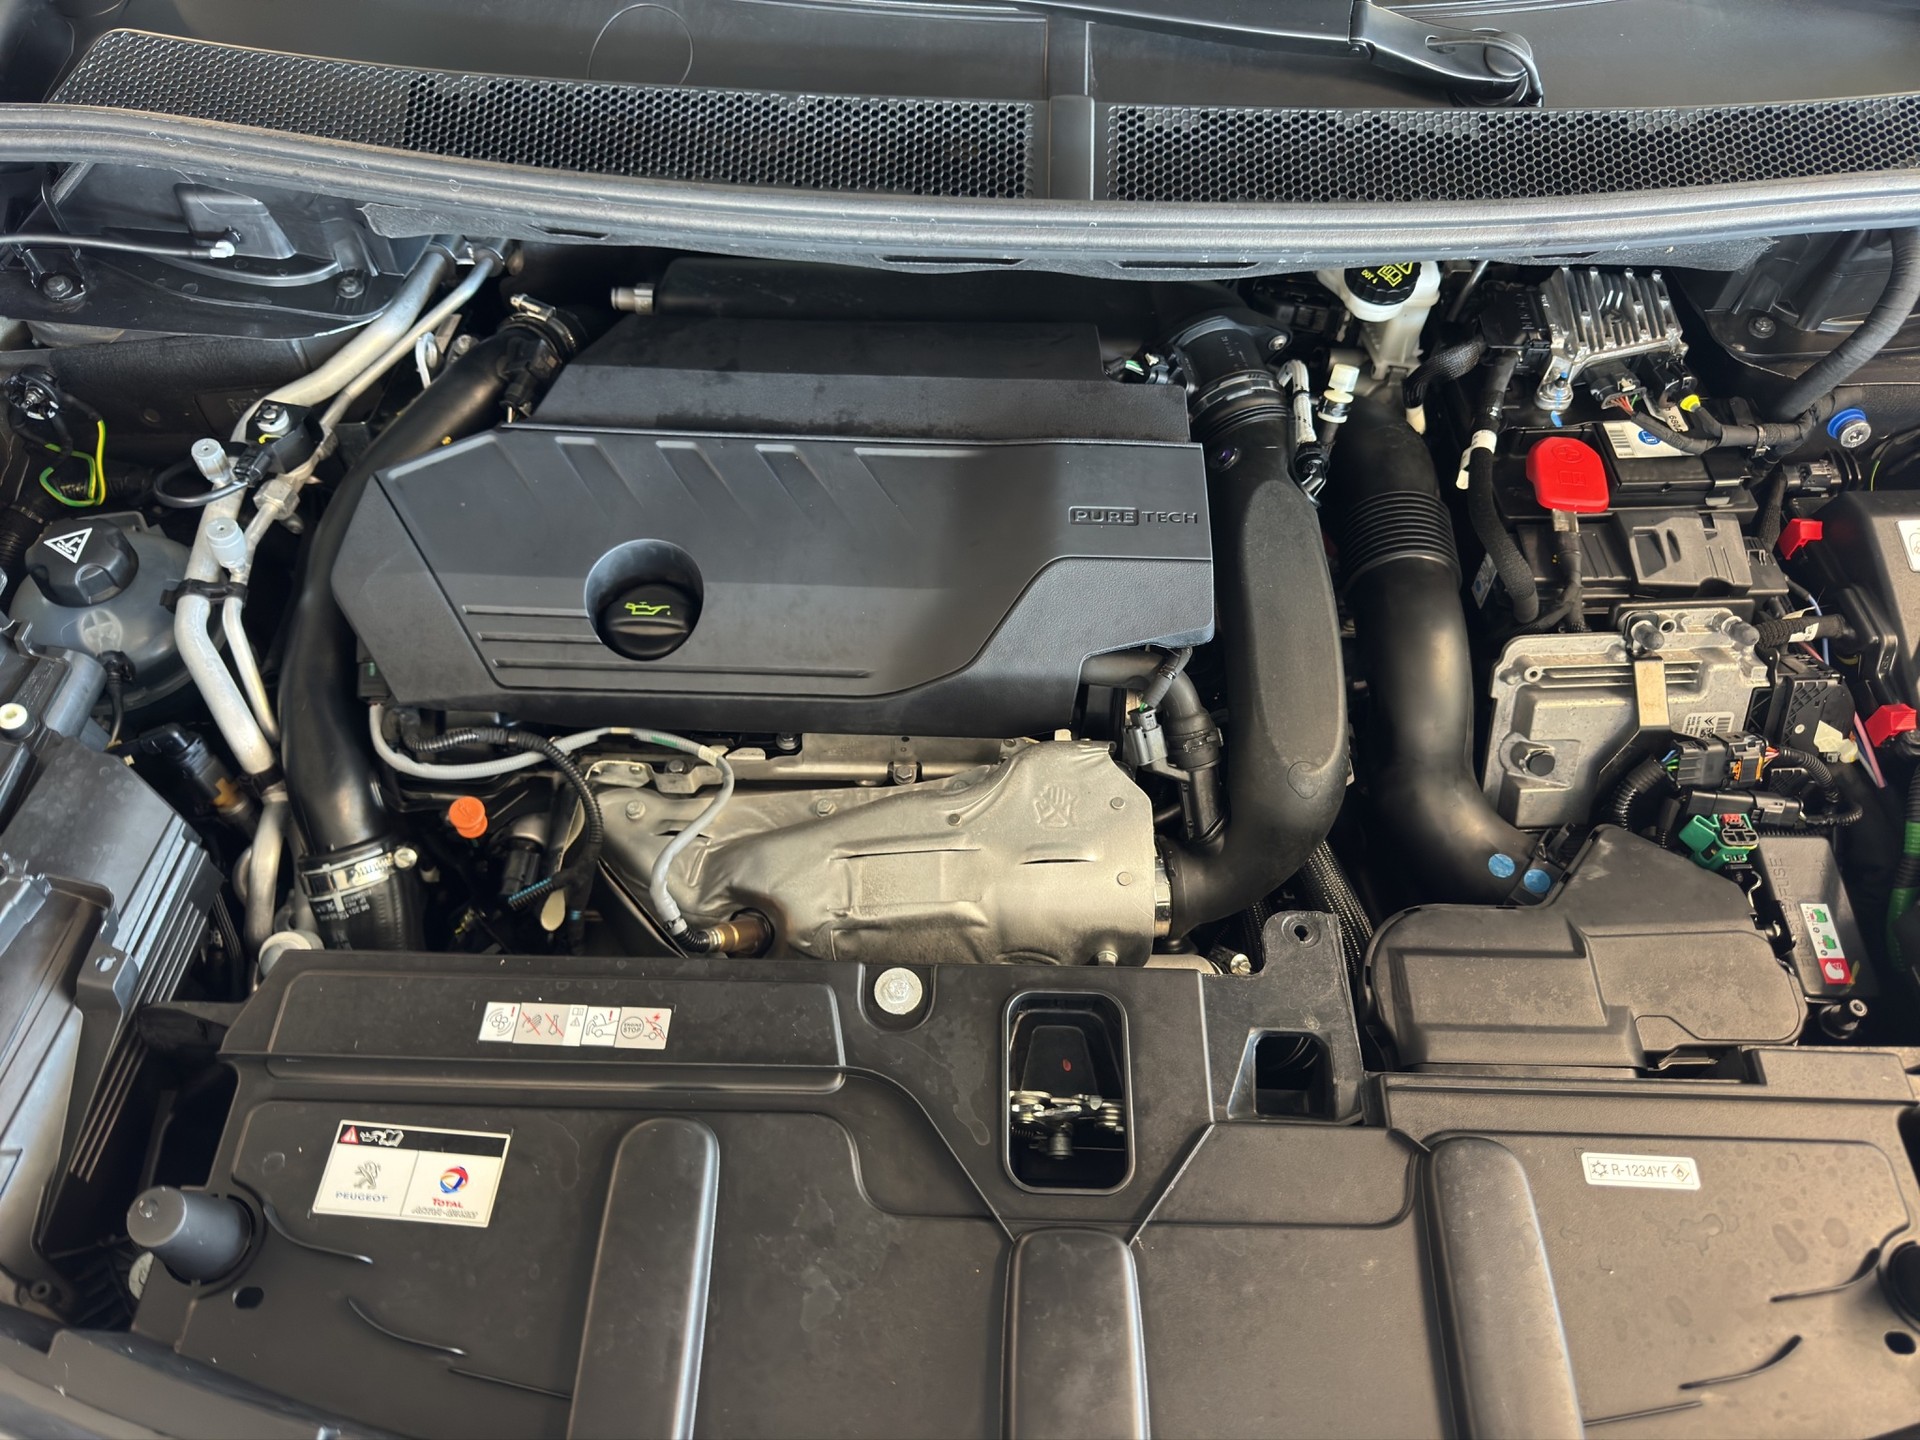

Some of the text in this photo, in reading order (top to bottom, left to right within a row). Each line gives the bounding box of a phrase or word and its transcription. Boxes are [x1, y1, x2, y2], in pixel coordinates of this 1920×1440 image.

[1074, 510, 1199, 524] PURE TECH
[1611, 1163, 1668, 1178] R-1234YF
[335, 1191, 388, 1203] PEUGEOT
[432, 1197, 464, 1209] TOTAL
